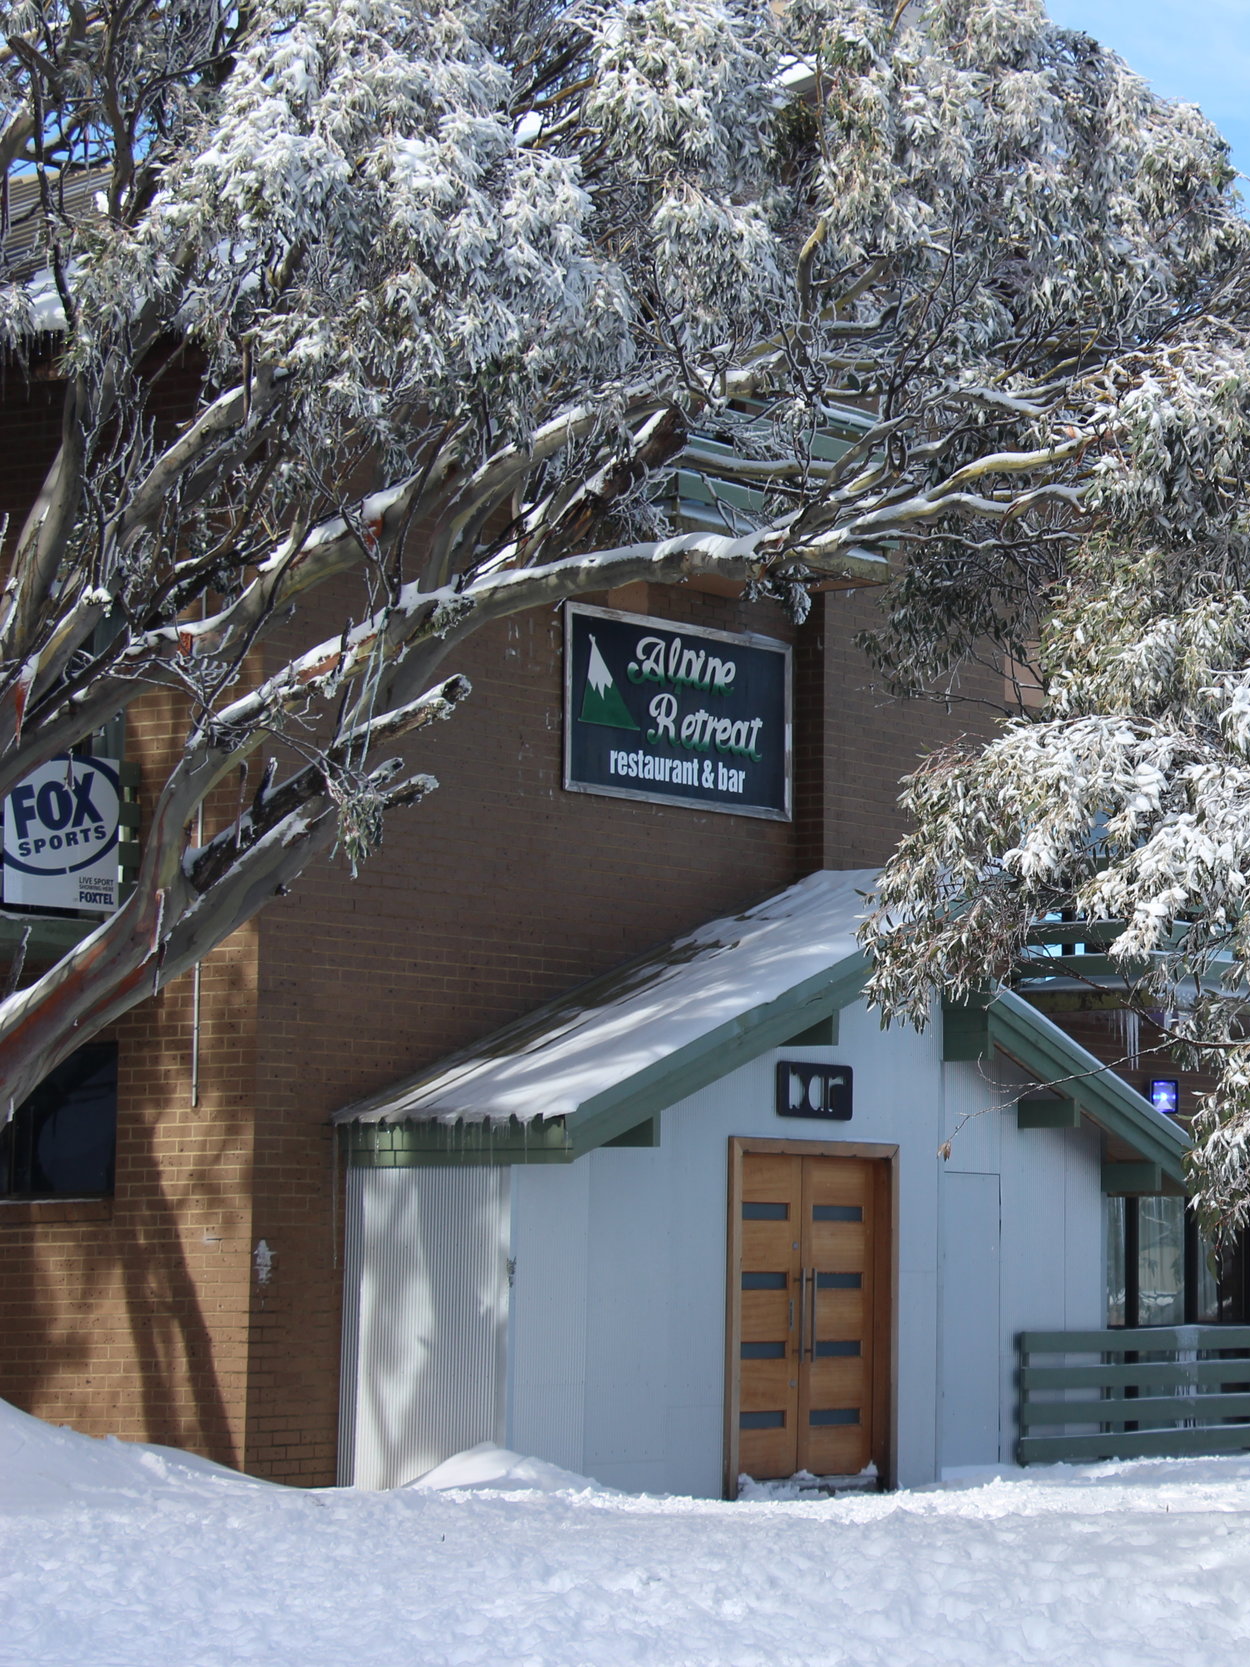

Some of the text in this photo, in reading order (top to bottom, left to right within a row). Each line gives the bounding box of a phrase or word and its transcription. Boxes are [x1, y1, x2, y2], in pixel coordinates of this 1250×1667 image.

[627, 637, 736, 696] Alpine
[647, 693, 763, 762] Retreat
[609, 750, 746, 793] restaurant & bar
[10, 771, 104, 840] FOX
[18, 825, 107, 857] SPORTS
[79, 876, 114, 887] LIVE SPORT
[79, 891, 114, 905] FOXTEL
[788, 1064, 845, 1112] bar
